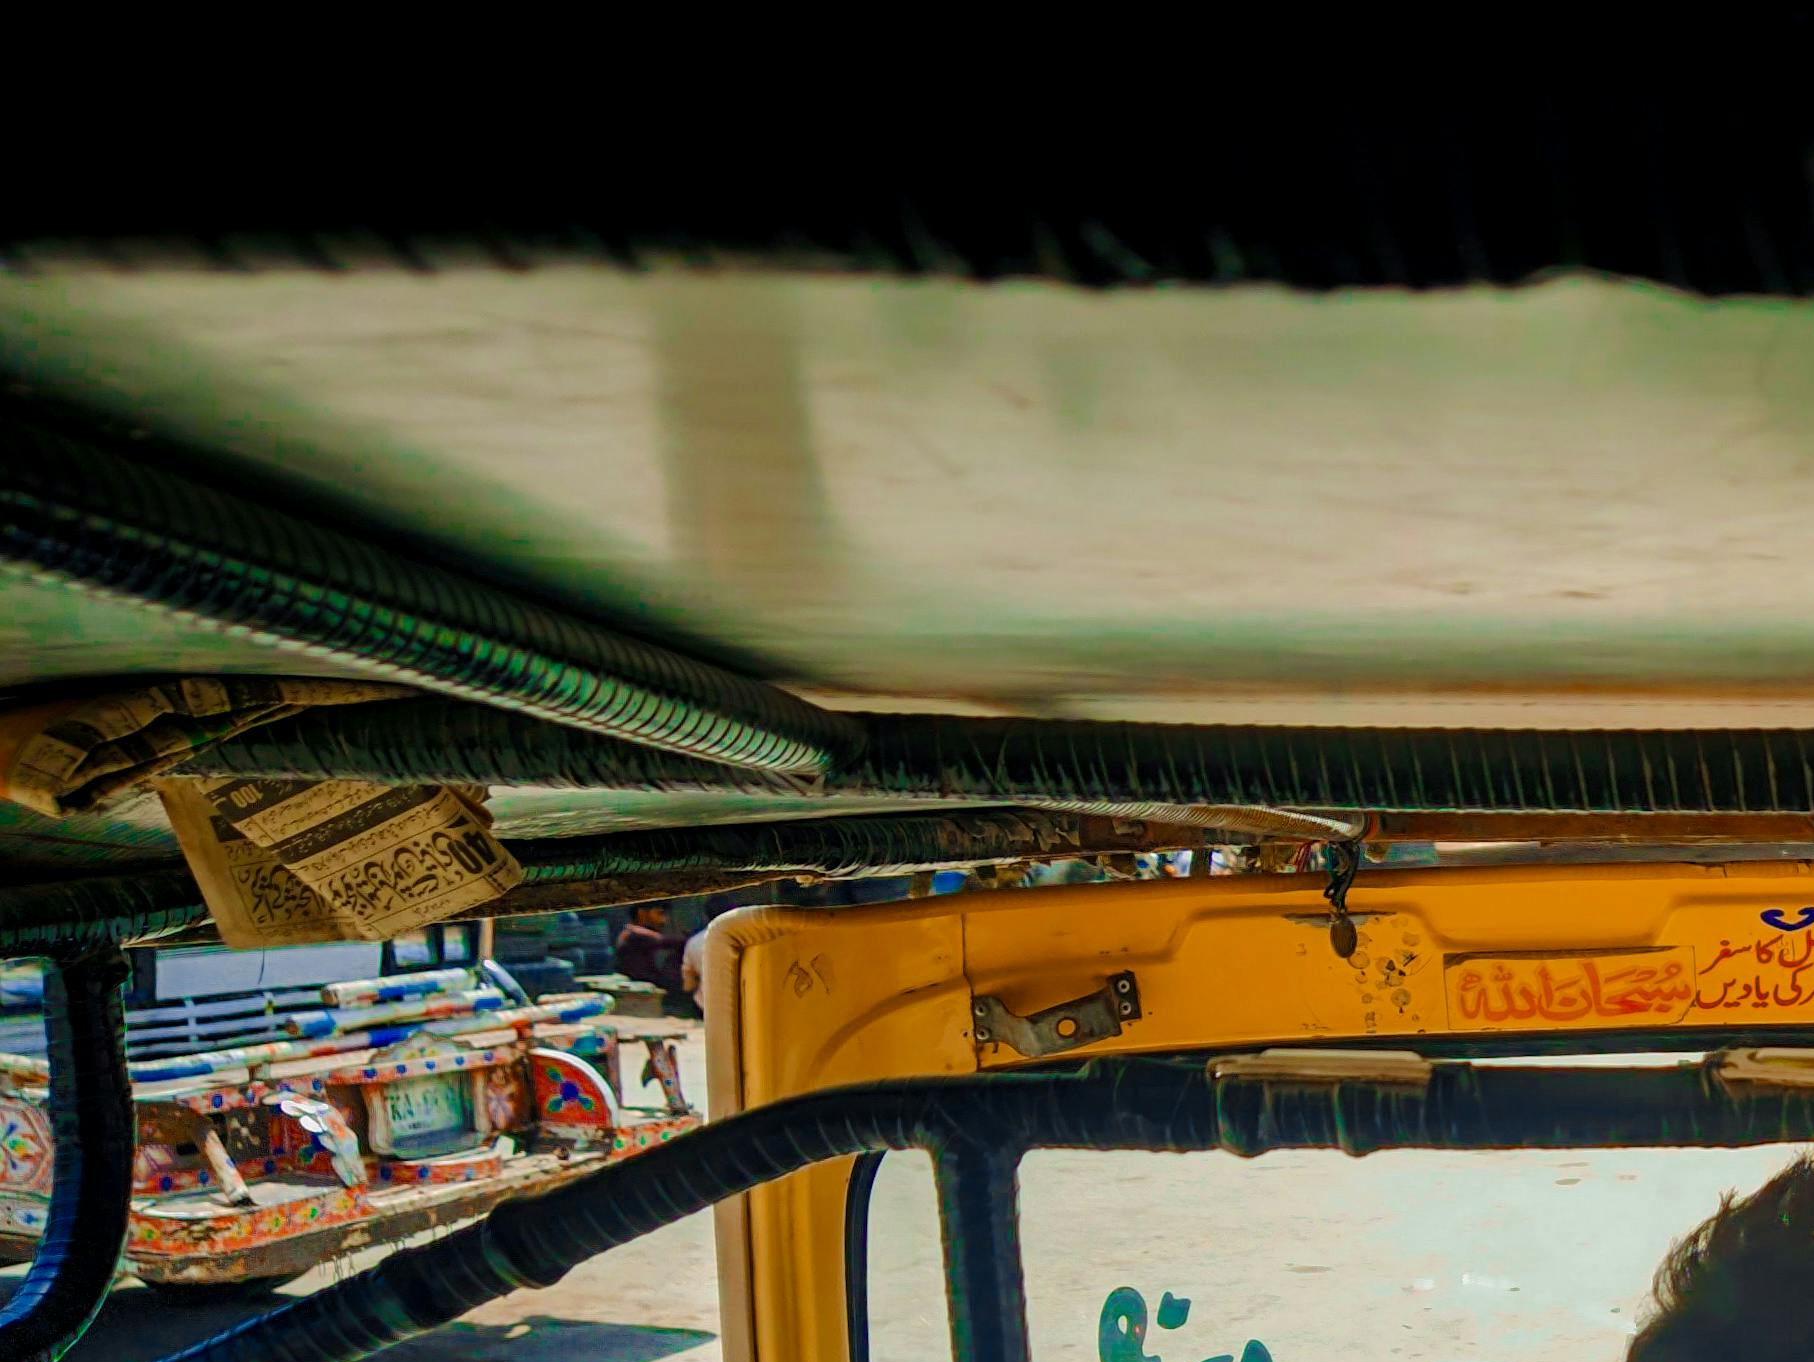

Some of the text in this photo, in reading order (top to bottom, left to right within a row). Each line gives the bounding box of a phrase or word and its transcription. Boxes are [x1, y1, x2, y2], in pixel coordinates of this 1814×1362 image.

[230, 784, 264, 808] 100
[446, 831, 497, 874] 40
[1698, 939, 1752, 975] سفر
[1756, 934, 1784, 964] کا
[1696, 975, 1769, 1009] یادیں
[1773, 962, 1814, 1006] کی
